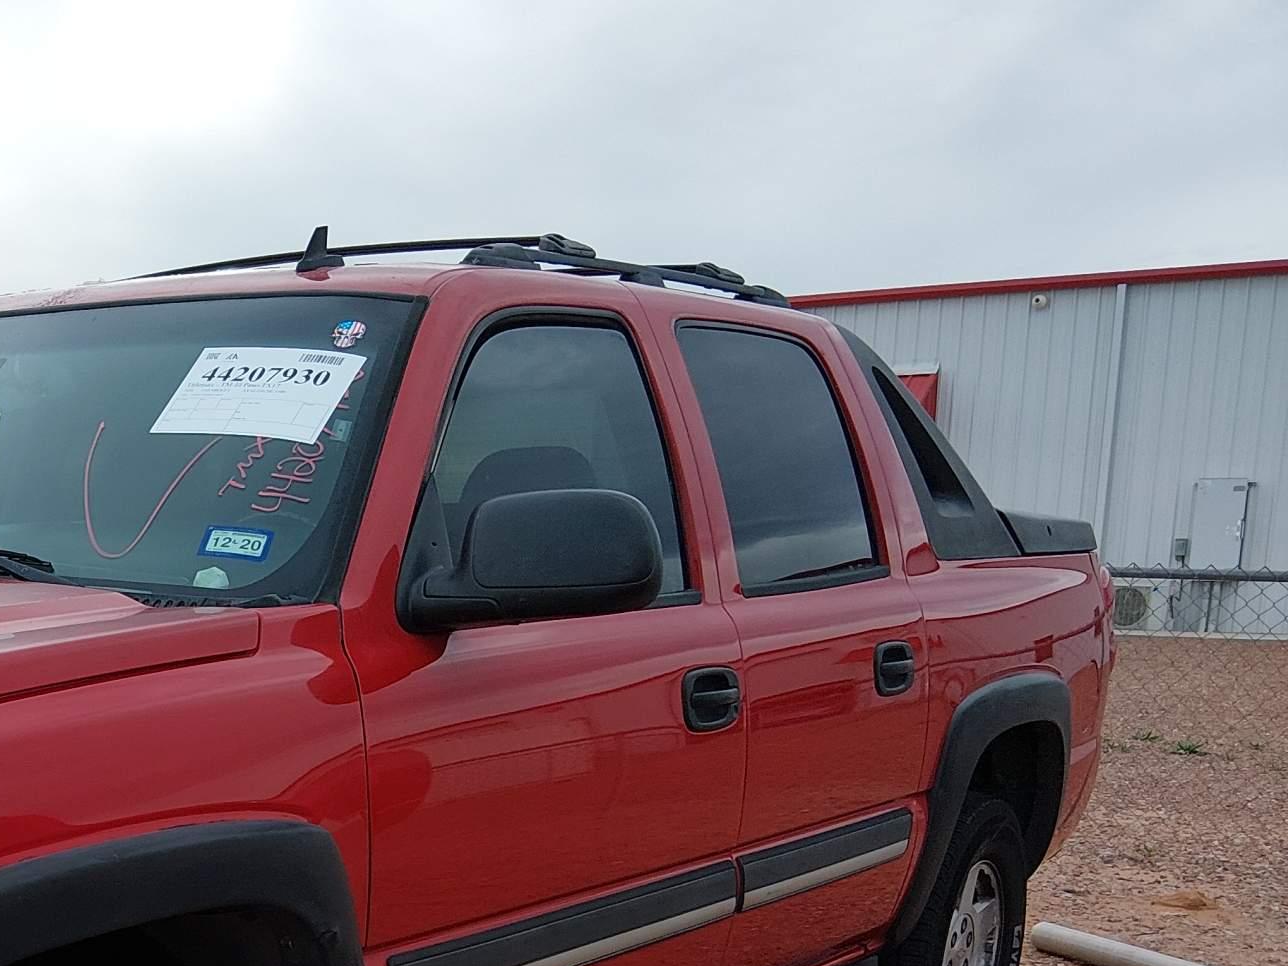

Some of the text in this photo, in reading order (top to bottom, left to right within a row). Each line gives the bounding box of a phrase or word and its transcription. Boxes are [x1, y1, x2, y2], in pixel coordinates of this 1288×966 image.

[201, 366, 331, 387] 44207930
[213, 536, 262, 551] 12 20
